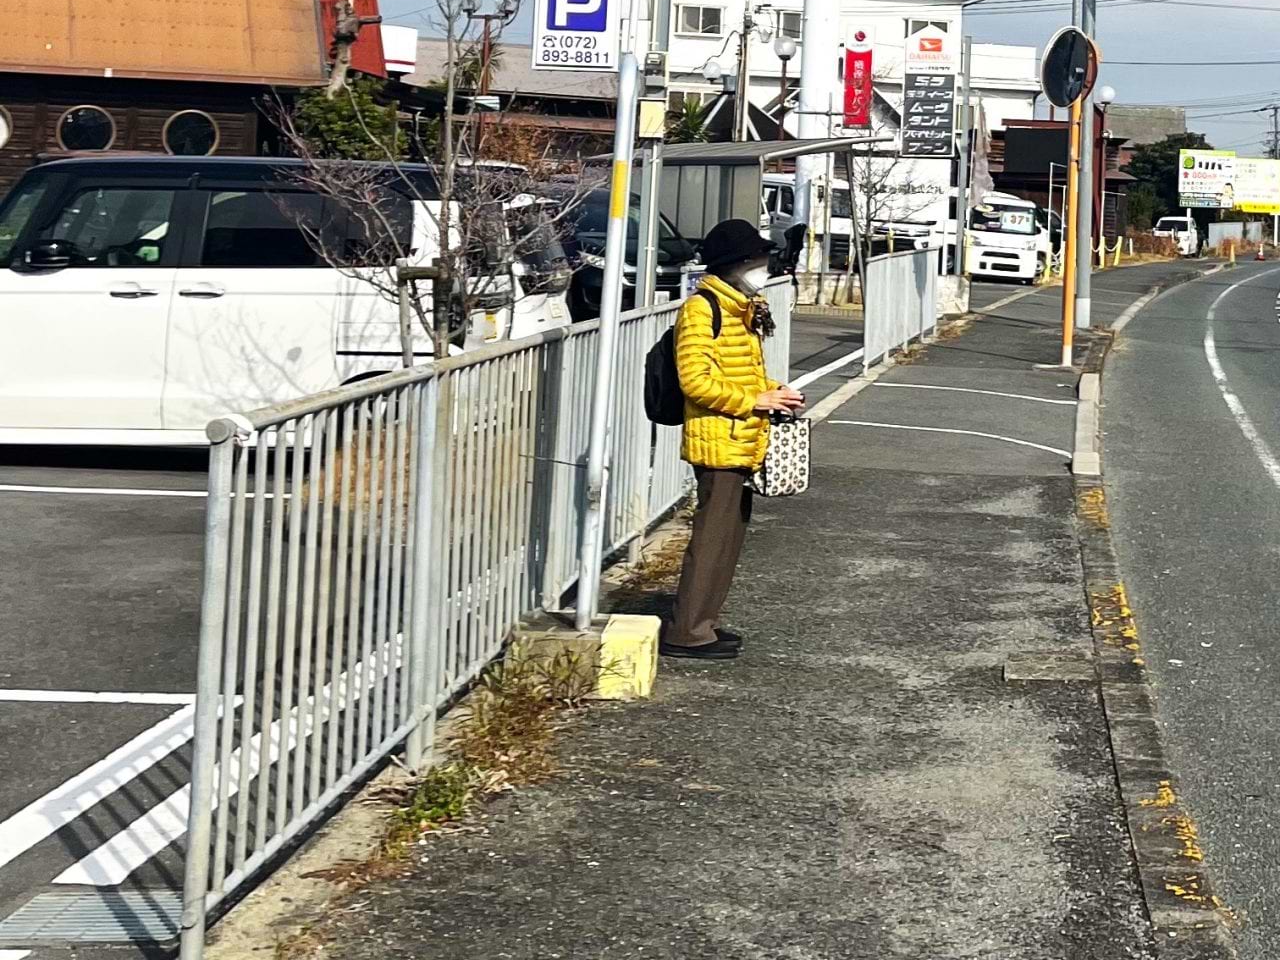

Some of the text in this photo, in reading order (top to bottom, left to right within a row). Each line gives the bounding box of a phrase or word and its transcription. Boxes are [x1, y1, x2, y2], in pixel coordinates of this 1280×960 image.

[559, 35, 598, 50] (072)
[541, 50, 610, 64] 893-8811
[914, 76, 946, 86] ミラ
[909, 101, 949, 113] ムーヴ
[908, 115, 950, 126] タント
